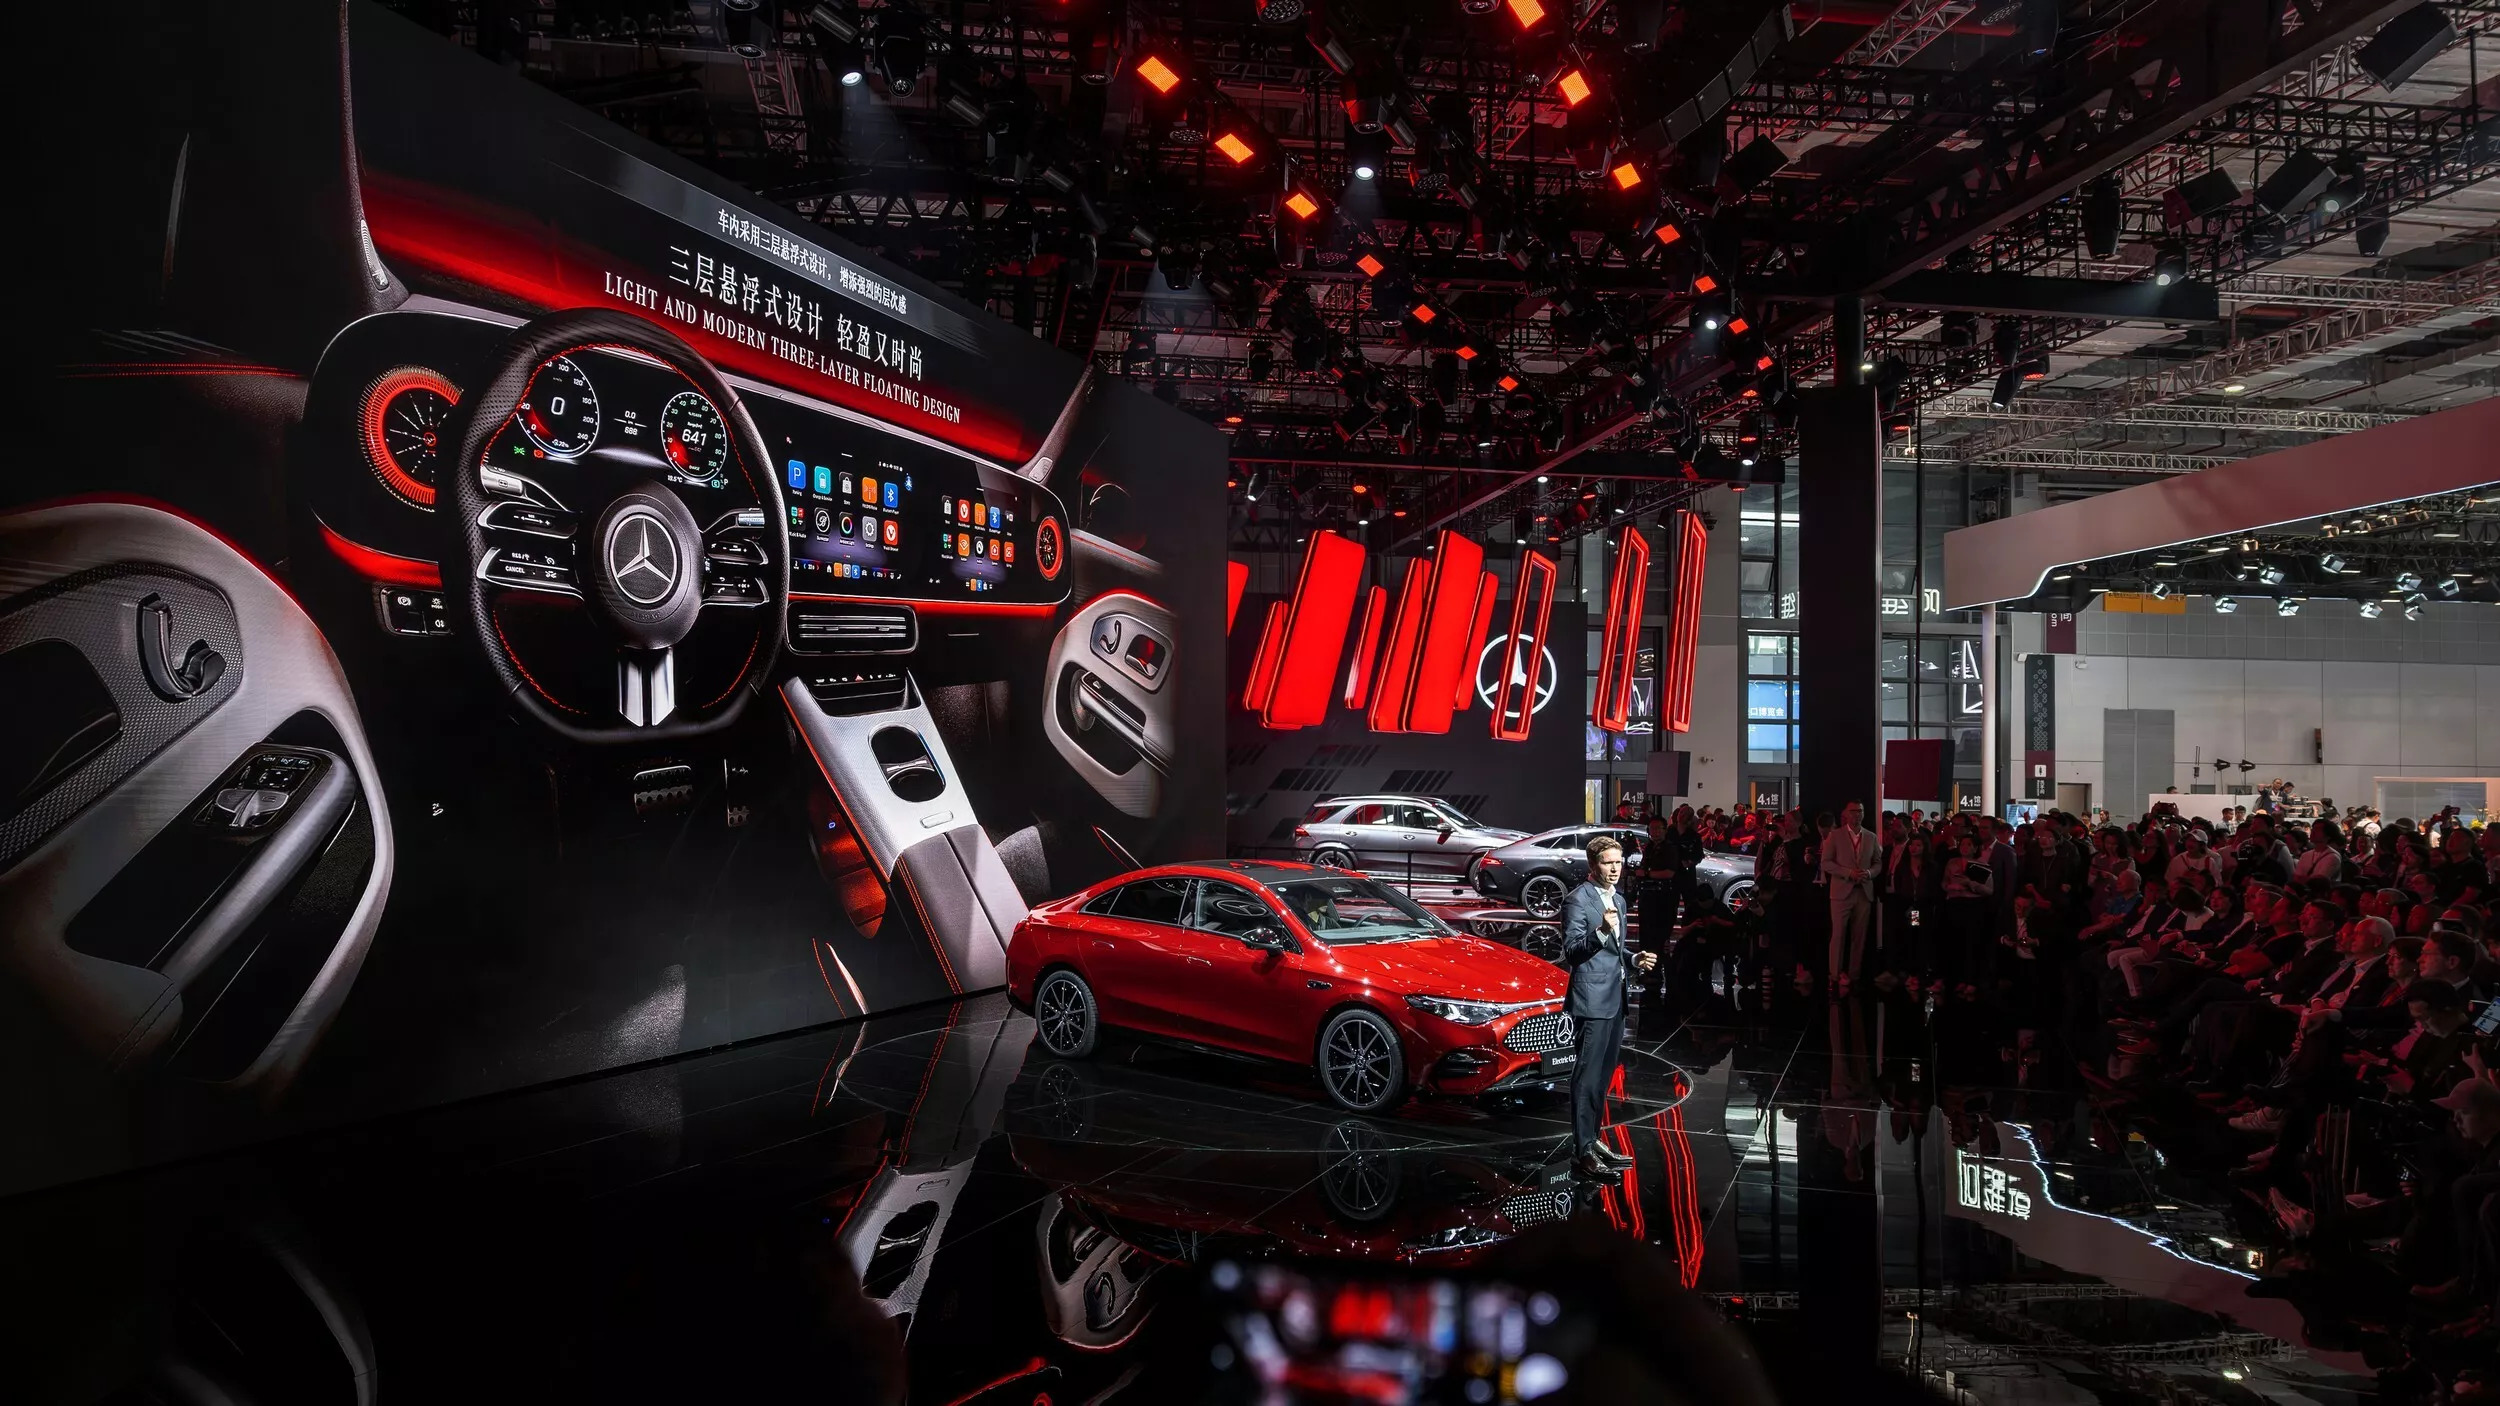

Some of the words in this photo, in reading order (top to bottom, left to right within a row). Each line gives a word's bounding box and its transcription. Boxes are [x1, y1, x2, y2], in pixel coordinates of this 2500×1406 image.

[839, 265, 907, 315] 增添强烈的层次感
[668, 245, 823, 341] 三层悬浮式设计
[837, 313, 922, 382] 轻盈又时尚
[604, 271, 658, 311] LIGHT
[663, 295, 697, 324] AND
[702, 309, 766, 351] MODERN
[770, 335, 860, 387] THREE-LAYER
[863, 371, 920, 408] FLOATING
[922, 394, 960, 424] DESIGN
[558, 364, 569, 372] 100
[573, 378, 584, 386] 120
[520, 402, 531, 410] 20
[551, 396, 565, 415] 0
[582, 416, 594, 424] 200
[624, 410, 636, 420] 0.0
[576, 432, 589, 441] 240
[681, 428, 707, 446] 641
[505, 565, 525, 574] CANCEL
[1551, 1056, 1569, 1066] Electric
